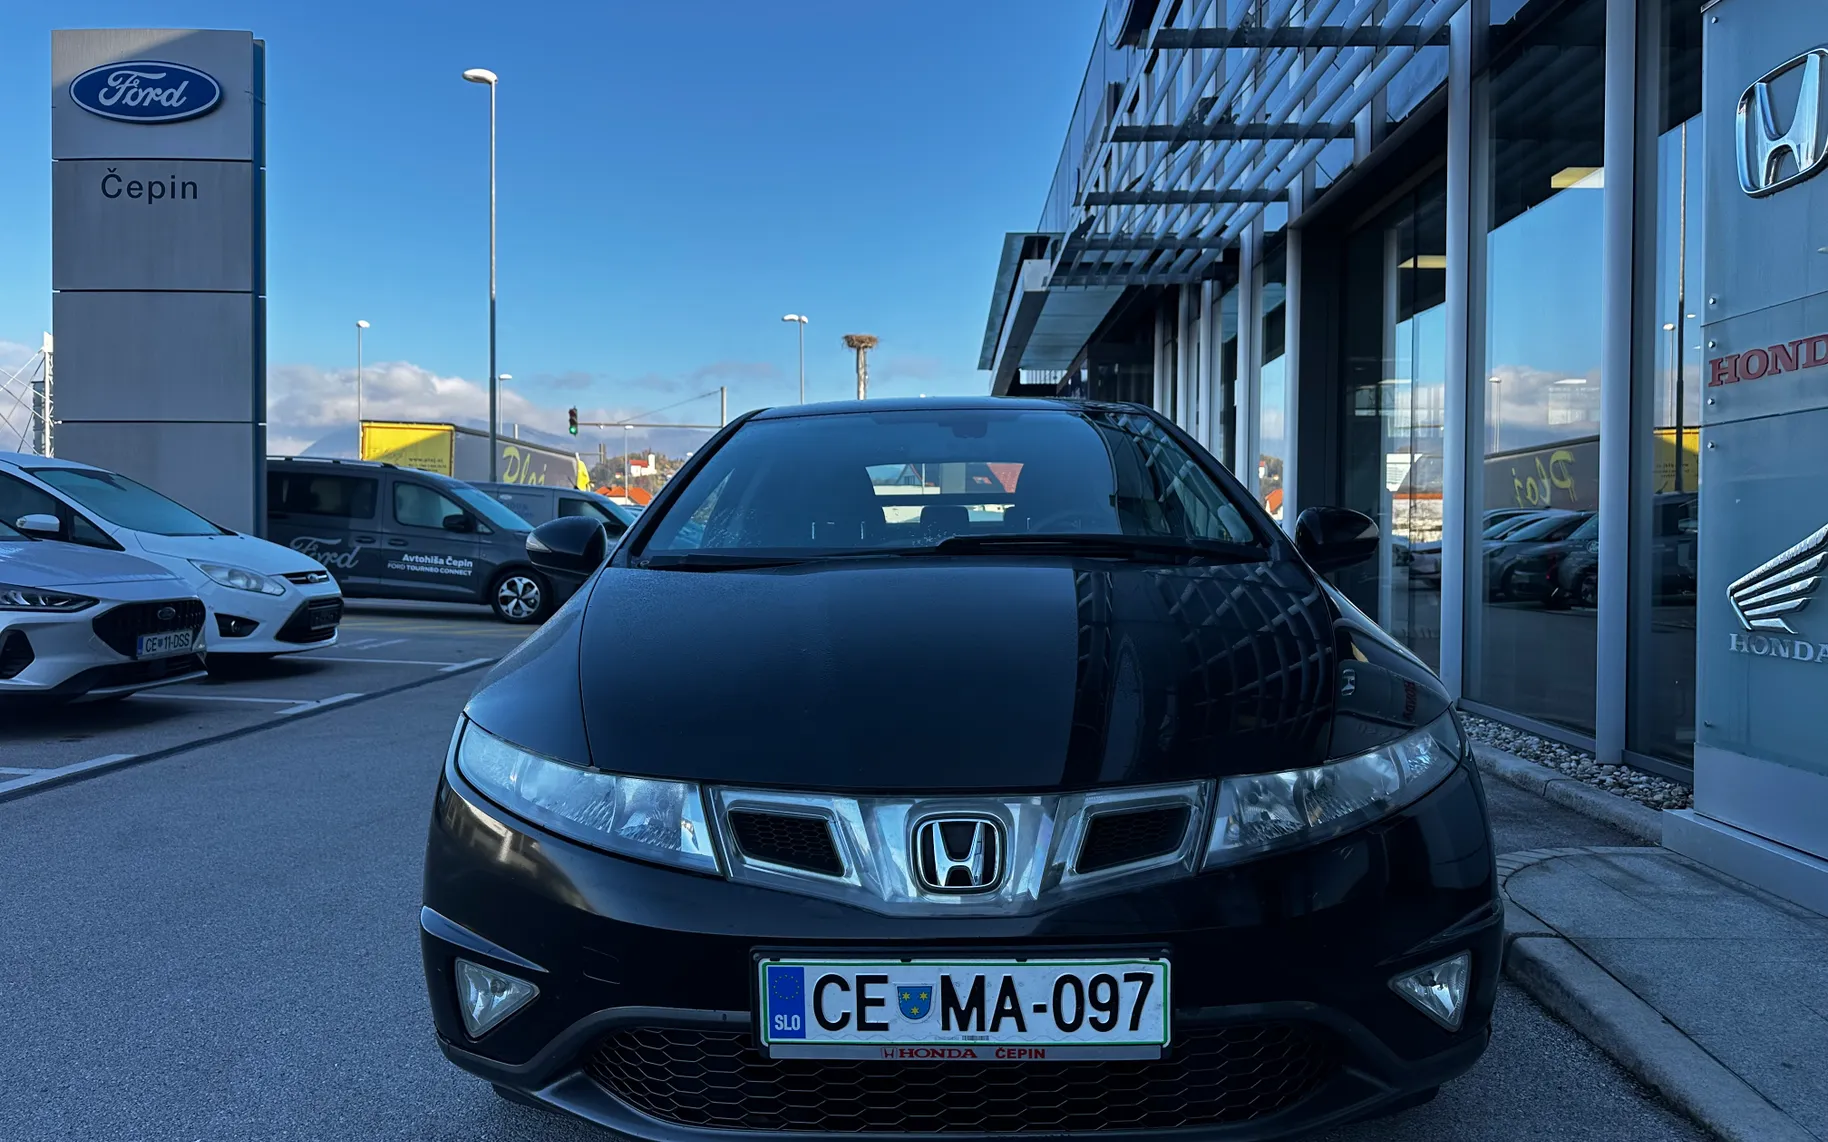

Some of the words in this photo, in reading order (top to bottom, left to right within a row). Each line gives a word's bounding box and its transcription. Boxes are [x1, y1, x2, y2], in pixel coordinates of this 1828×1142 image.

[98, 70, 189, 107] Ford
[101, 167, 198, 205] Čepin
[387, 563, 406, 571] FORD
[406, 564, 439, 574] TOURNEO
[440, 567, 473, 576] CONNECT
[402, 553, 444, 565] Avtohiša
[445, 555, 473, 568] Čepin
[145, 637, 158, 652] CE
[164, 633, 190, 649] 11-DSS
[1728, 633, 1828, 663] HONDA
[812, 973, 890, 1032] CE
[940, 972, 1155, 1033] MA-097
[774, 1014, 801, 1031] SLO
[898, 1048, 977, 1059] HONDA
[995, 1047, 1046, 1059] ČEPIN
